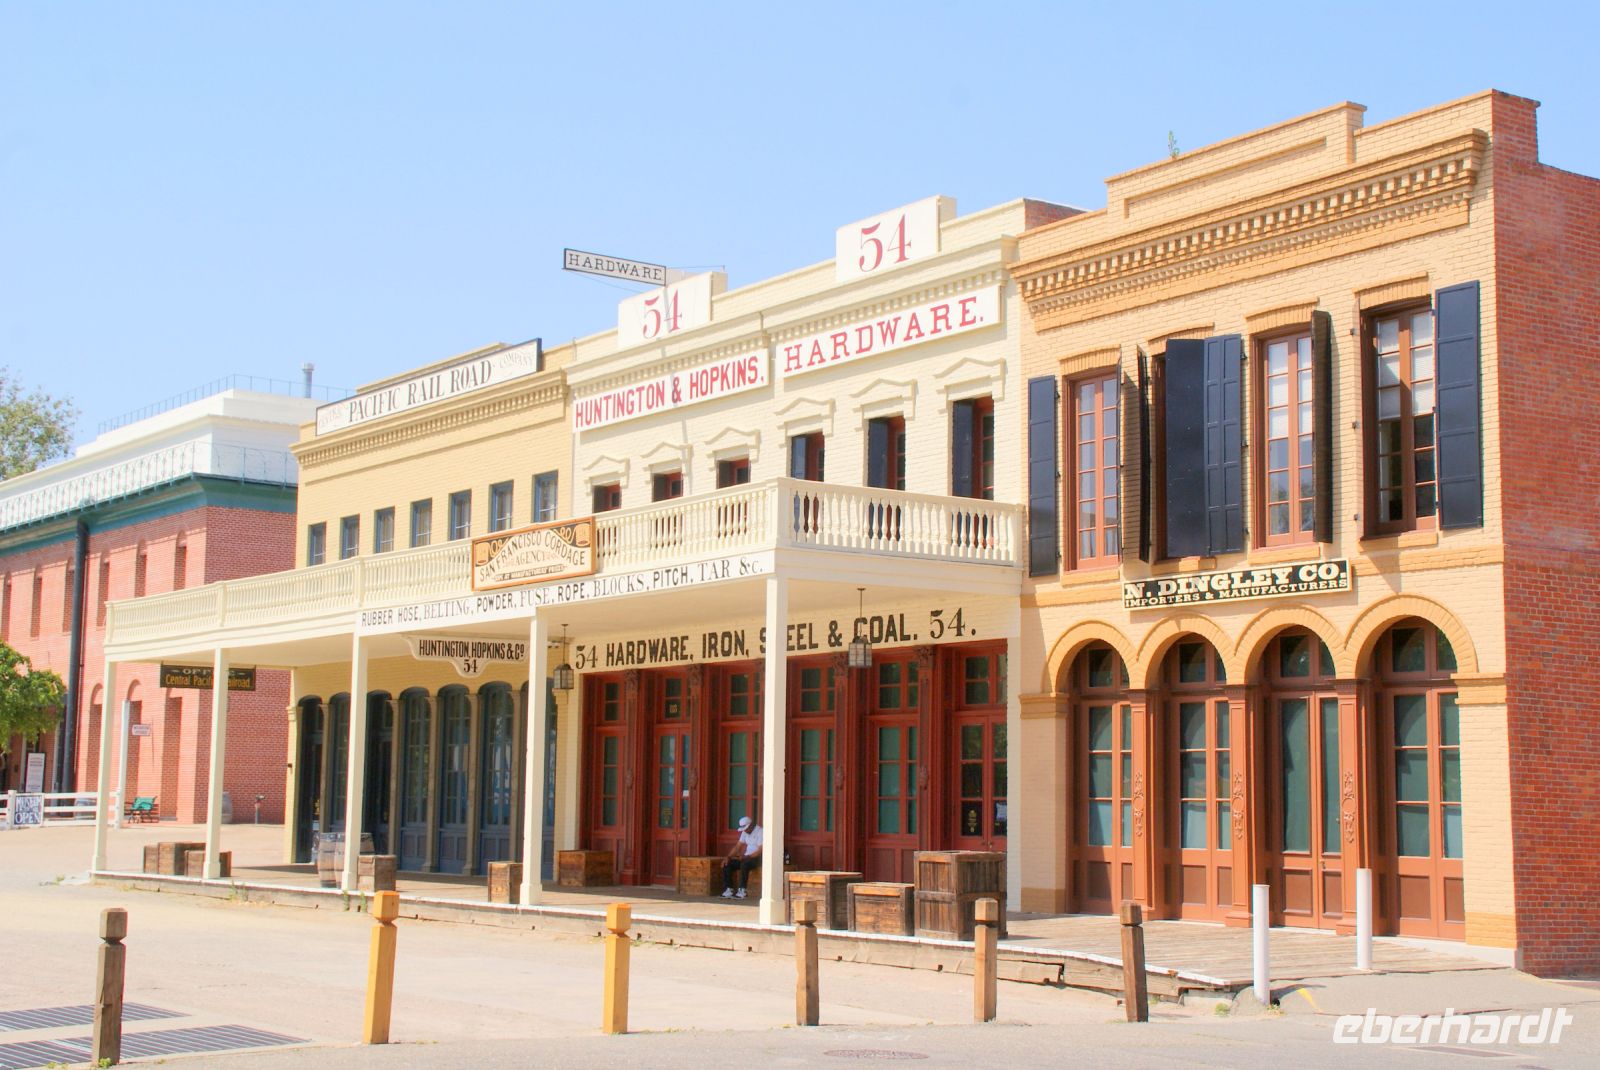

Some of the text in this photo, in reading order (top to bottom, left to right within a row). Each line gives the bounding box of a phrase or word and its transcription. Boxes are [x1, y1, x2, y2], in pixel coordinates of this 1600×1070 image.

[858, 214, 912, 272] 54
[568, 253, 662, 281] HARDWARE
[643, 289, 682, 339] 54
[783, 296, 984, 372] HARDWARE.
[350, 387, 400, 422] PACIFIC
[407, 381, 444, 405] RAIL
[450, 360, 492, 393] ROAD
[575, 380, 665, 428] HUNTINGTON
[671, 376, 682, 404] &
[480, 529, 585, 582] SAN FRANCISCO CORDAGE
[515, 550, 545, 566] AGENCY
[362, 609, 393, 627] RUBBER
[424, 599, 474, 620] BELTING,
[698, 559, 730, 581] TAR
[1125, 563, 1346, 599] N. DINGLEY CO.
[1125, 579, 1347, 609] IMPORTERS & MANUFACTURERS
[471, 641, 506, 660] HOPKINS
[506, 643, 514, 660] &
[575, 607, 976, 670] 54 HARDWARE, IRON, SEEL & COAL. 54.
[165, 673, 190, 685] Central
[463, 659, 477, 673] 54
[15, 812, 40, 824] OPEN
